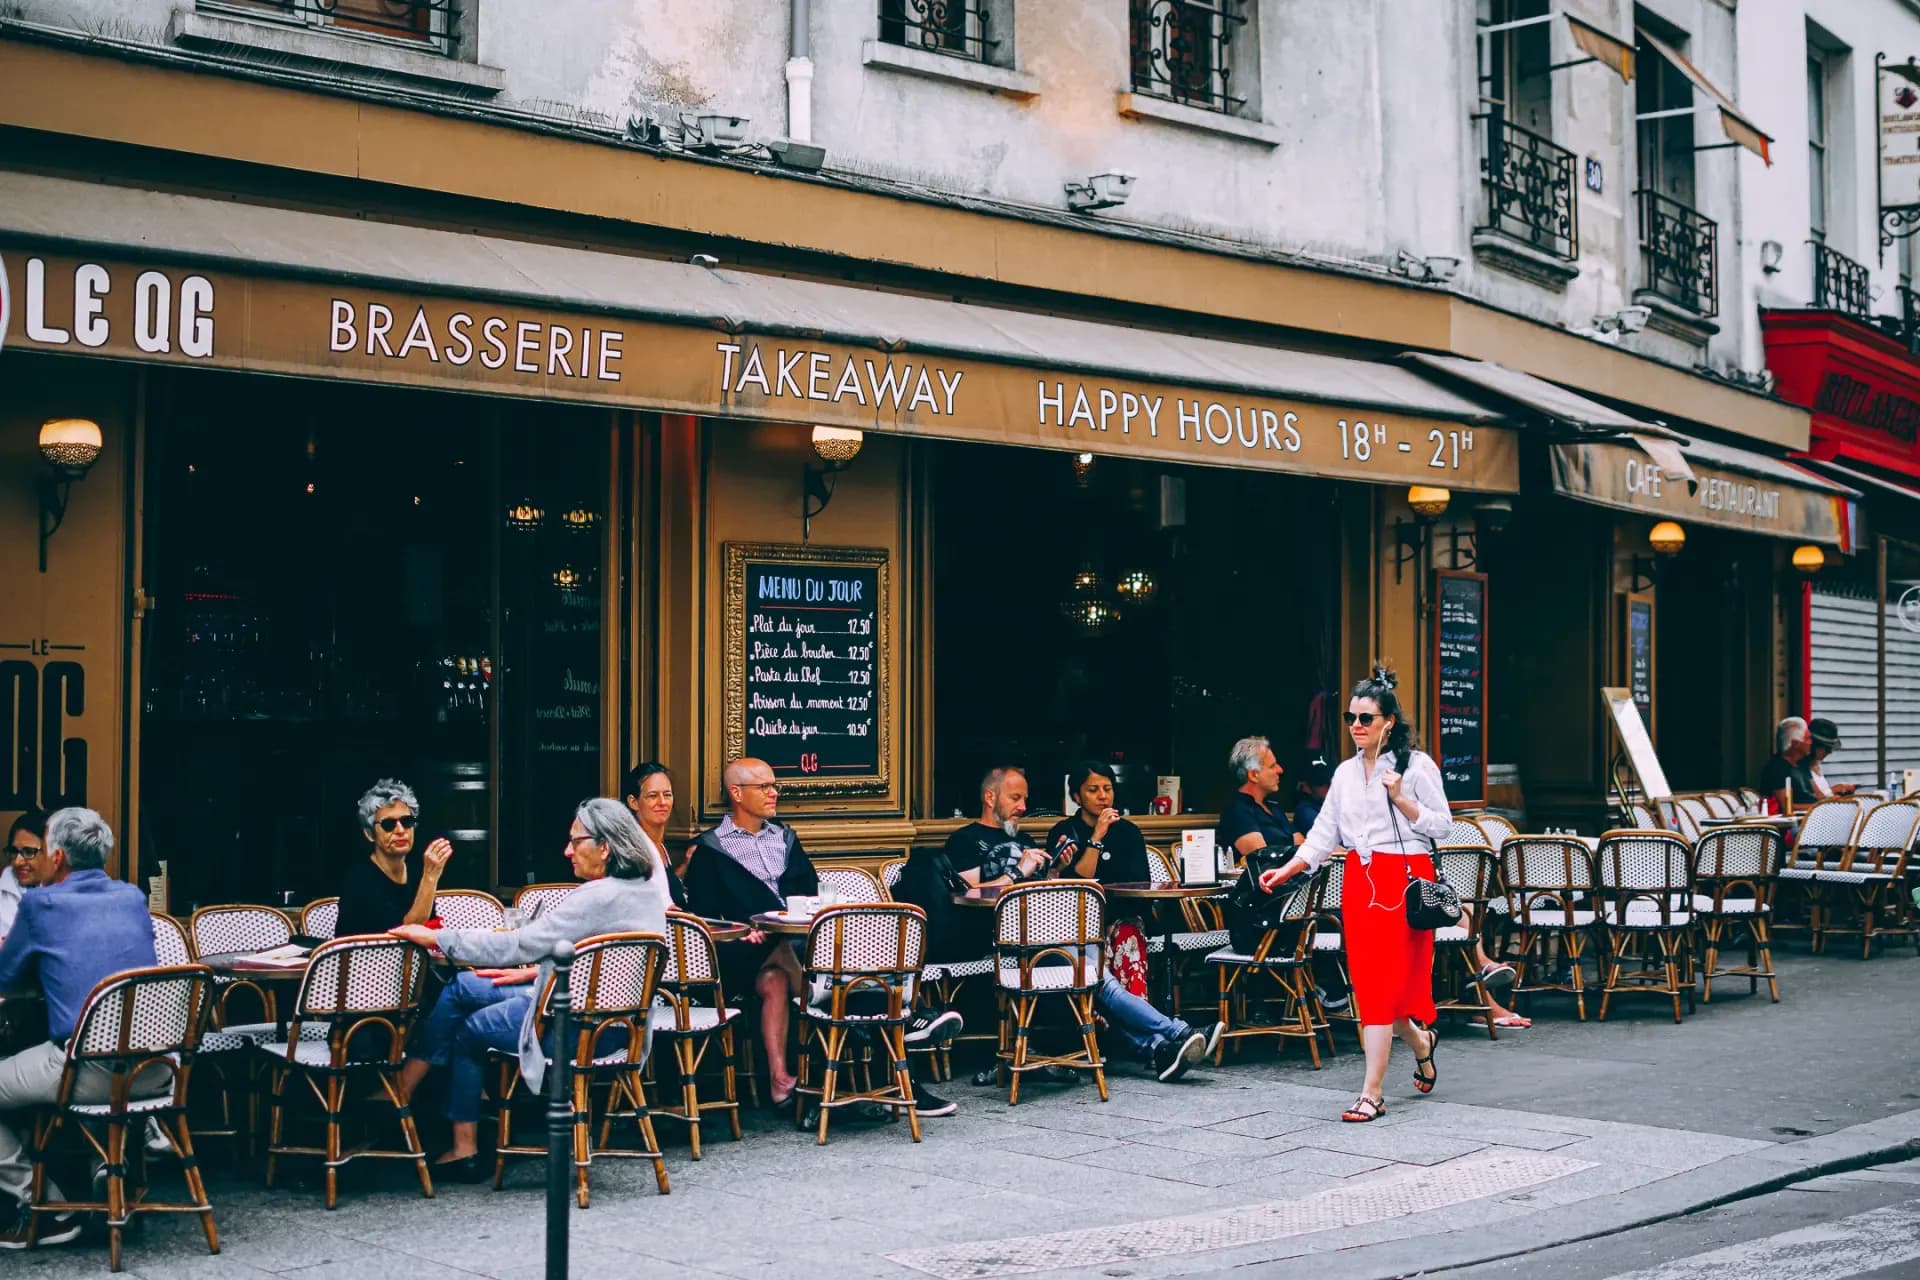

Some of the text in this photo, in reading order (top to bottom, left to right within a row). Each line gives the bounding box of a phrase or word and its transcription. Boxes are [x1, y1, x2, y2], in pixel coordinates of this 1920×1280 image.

[24, 256, 112, 347] LE
[134, 270, 214, 358] QG
[329, 297, 624, 381] BRASSERIE
[717, 343, 963, 416] TAKEAWAY
[1037, 380, 1163, 437] HAPPY
[1177, 399, 1301, 452] HOURS
[1700, 476, 1780, 519] RESTAURANT
[758, 575, 863, 603] MENU DU JOUR
[753, 614, 774, 633] Plat
[777, 616, 793, 633] du
[795, 618, 816, 639] jour
[31, 639, 49, 656] LE
[754, 641, 779, 660] Pièce
[781, 642, 798, 658] du
[754, 665, 781, 682] Pasta
[784, 666, 799, 682] du
[753, 691, 786, 709] Poisson
[790, 691, 803, 709] du
[806, 696, 843, 709] moment
[755, 716, 787, 736] Quiche
[788, 720, 800, 734] du
[801, 721, 819, 740] jour
